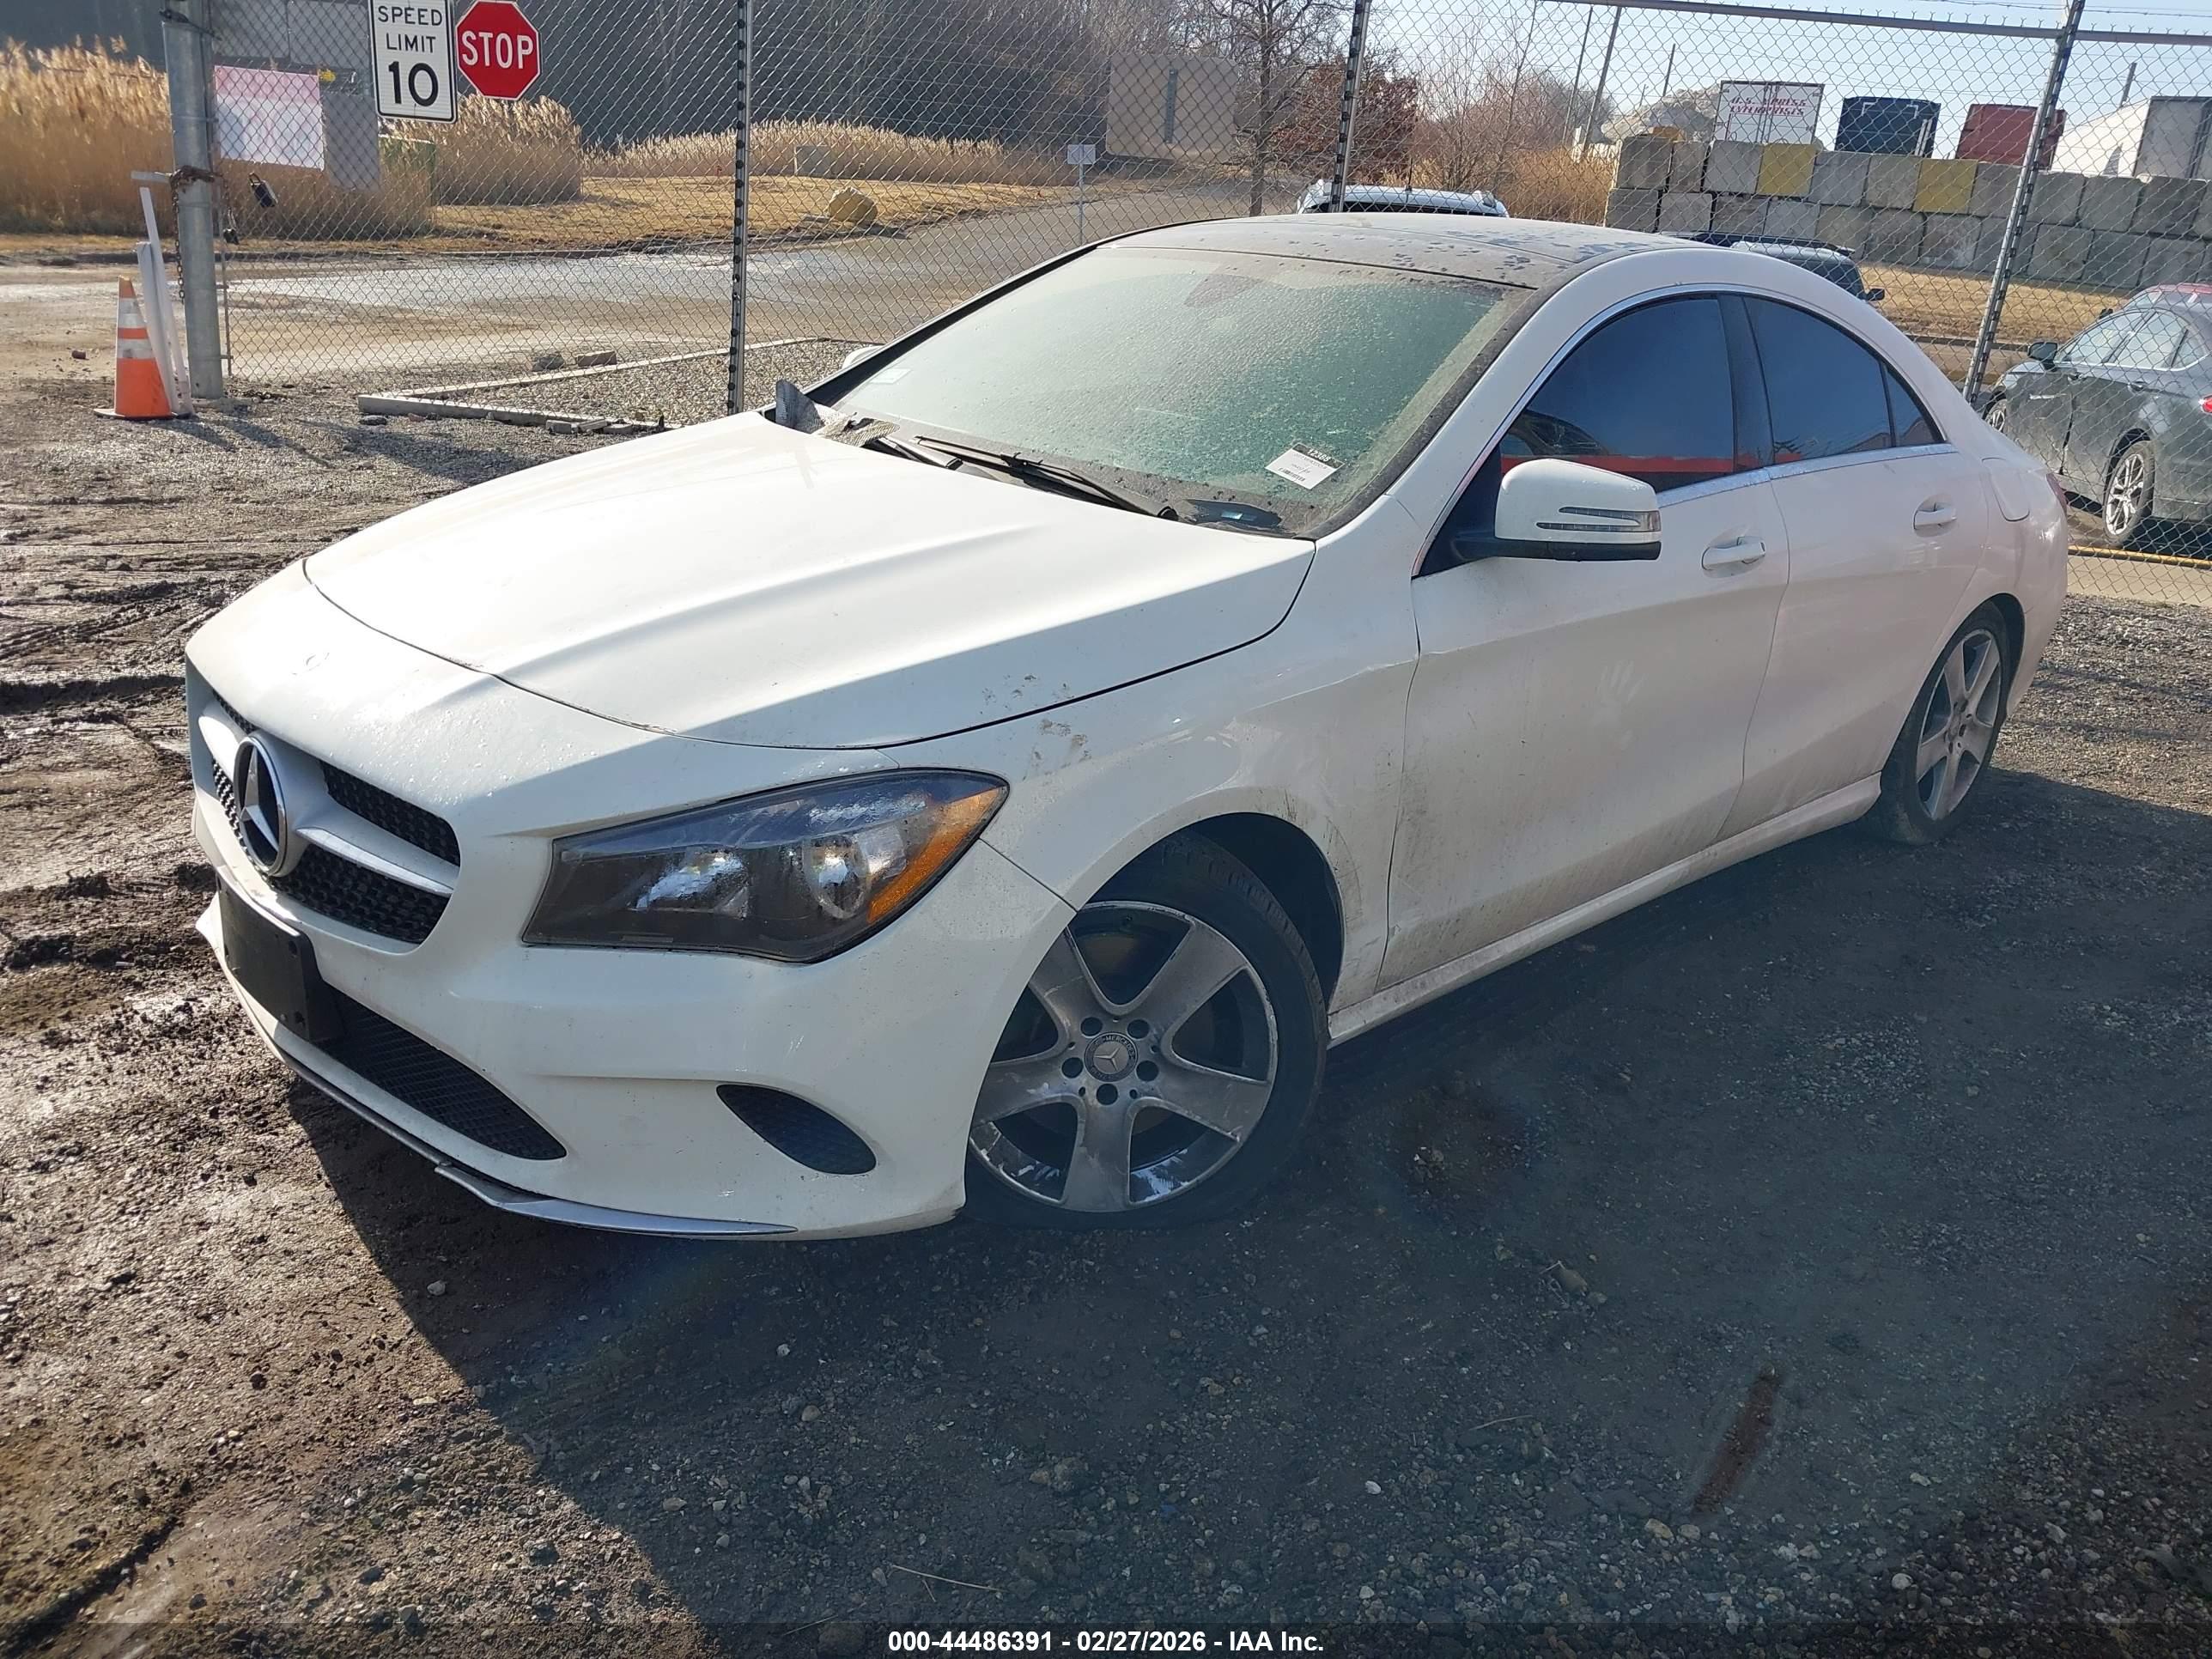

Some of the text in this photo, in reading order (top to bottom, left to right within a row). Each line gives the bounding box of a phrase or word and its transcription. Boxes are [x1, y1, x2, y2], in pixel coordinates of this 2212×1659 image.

[378, 6, 443, 26] SPEED
[386, 33, 436, 53] LIMIT
[461, 30, 534, 70] STOP
[388, 61, 439, 106] 10
